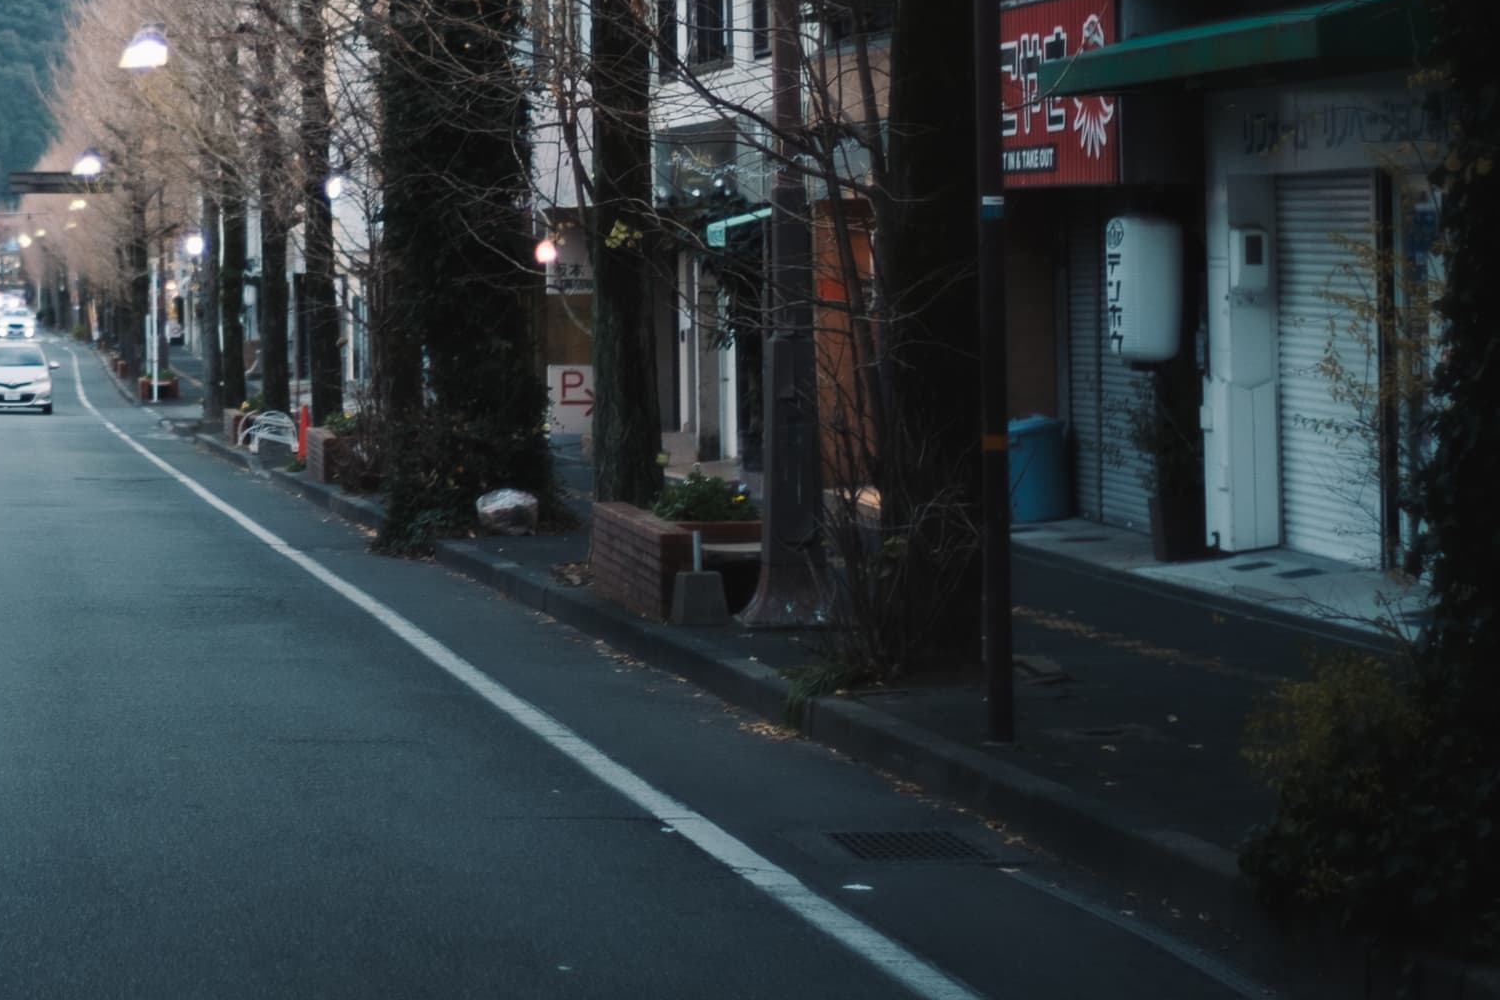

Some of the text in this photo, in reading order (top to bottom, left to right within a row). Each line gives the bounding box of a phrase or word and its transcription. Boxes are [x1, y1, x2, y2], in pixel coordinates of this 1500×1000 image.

[1021, 148, 1038, 169] TAKE
[1039, 147, 1054, 168] OUT
[561, 370, 584, 400] P
